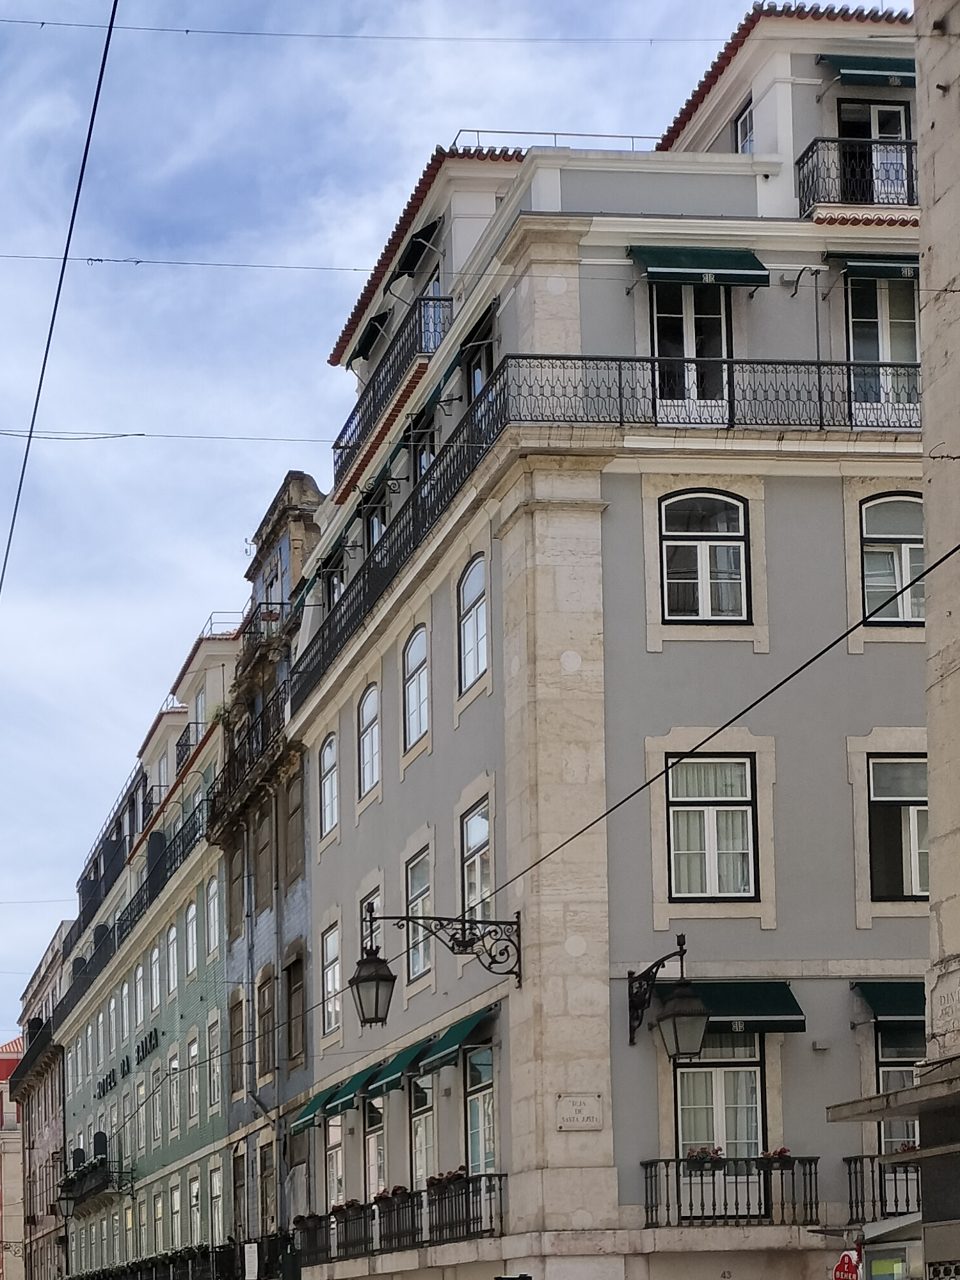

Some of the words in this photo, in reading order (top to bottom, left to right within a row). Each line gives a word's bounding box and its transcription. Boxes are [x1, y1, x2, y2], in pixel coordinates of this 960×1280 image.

[97, 1068, 117, 1100] HOTEL
[121, 1055, 130, 1079] DA
[136, 1027, 159, 1066] BAIXA
[720, 1270, 732, 1280] 43
